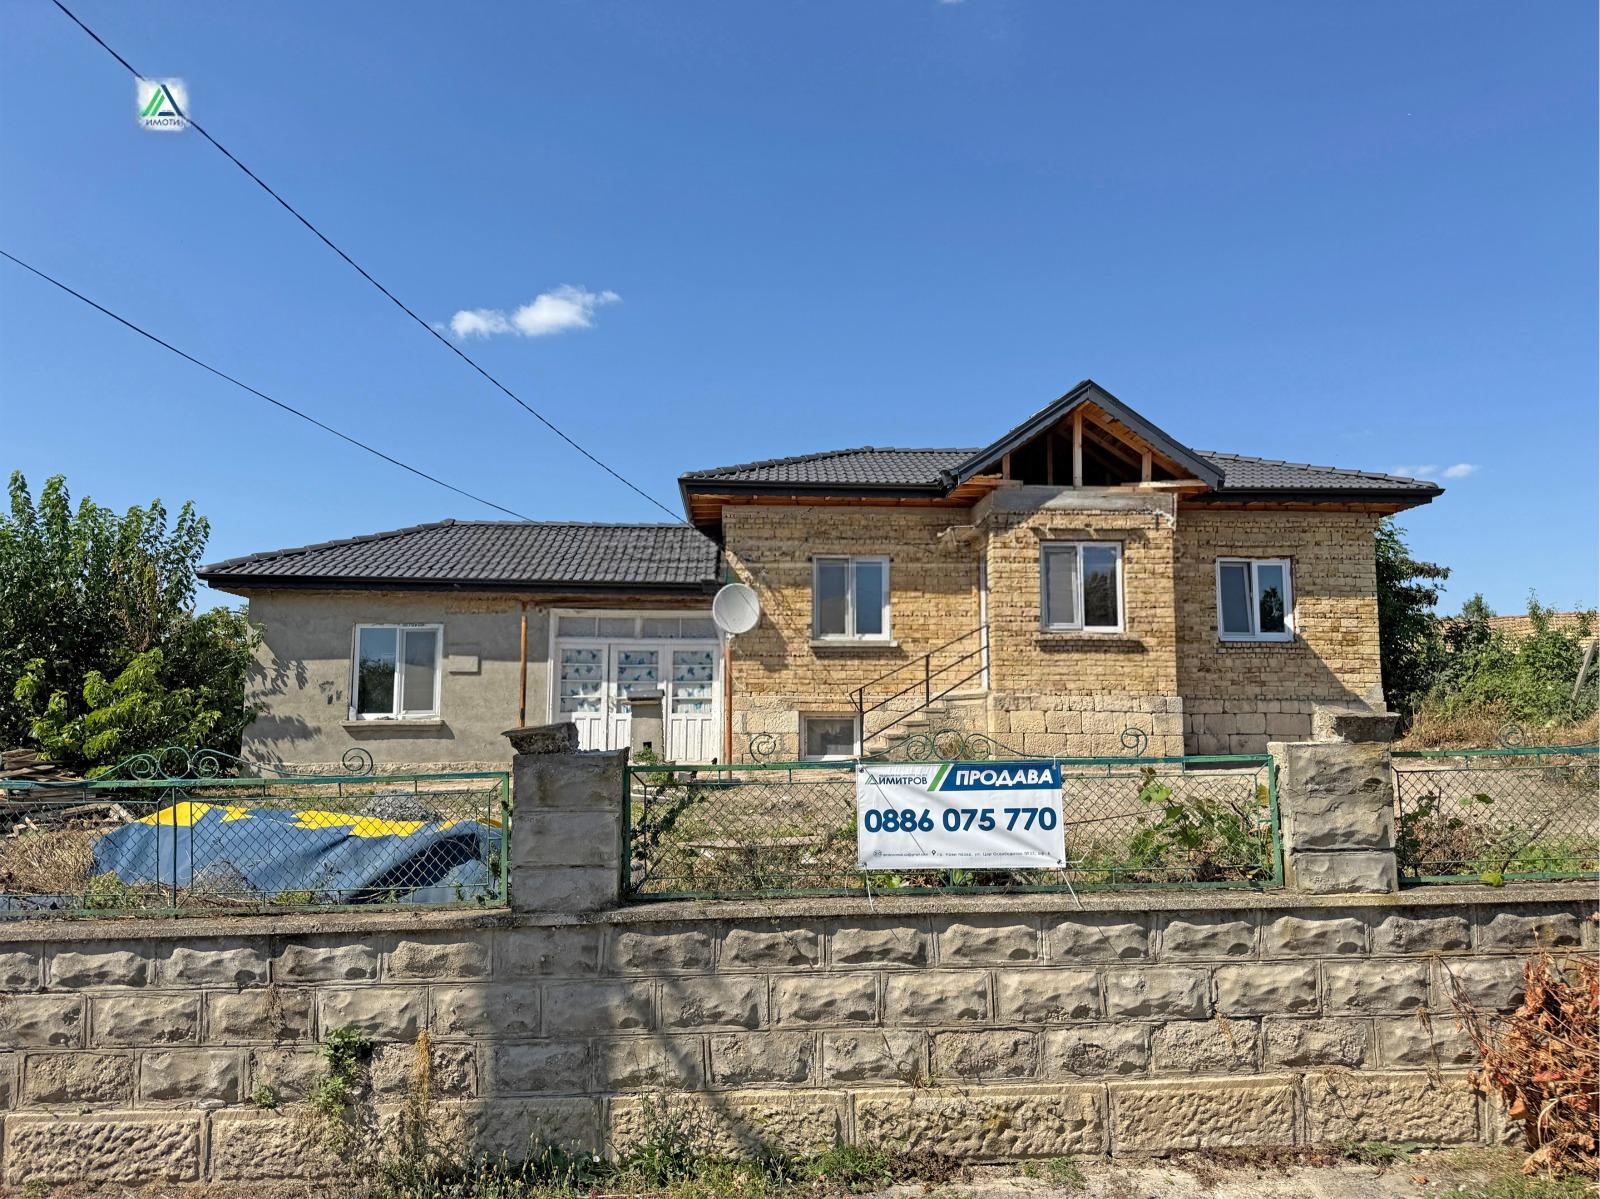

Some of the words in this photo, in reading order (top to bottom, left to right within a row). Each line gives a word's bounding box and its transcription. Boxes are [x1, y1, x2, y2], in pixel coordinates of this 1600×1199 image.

[955, 769, 1054, 787] ПРОДАВА
[864, 808, 935, 833] 0886
[942, 808, 996, 832] 075
[1004, 807, 1057, 831] 770
